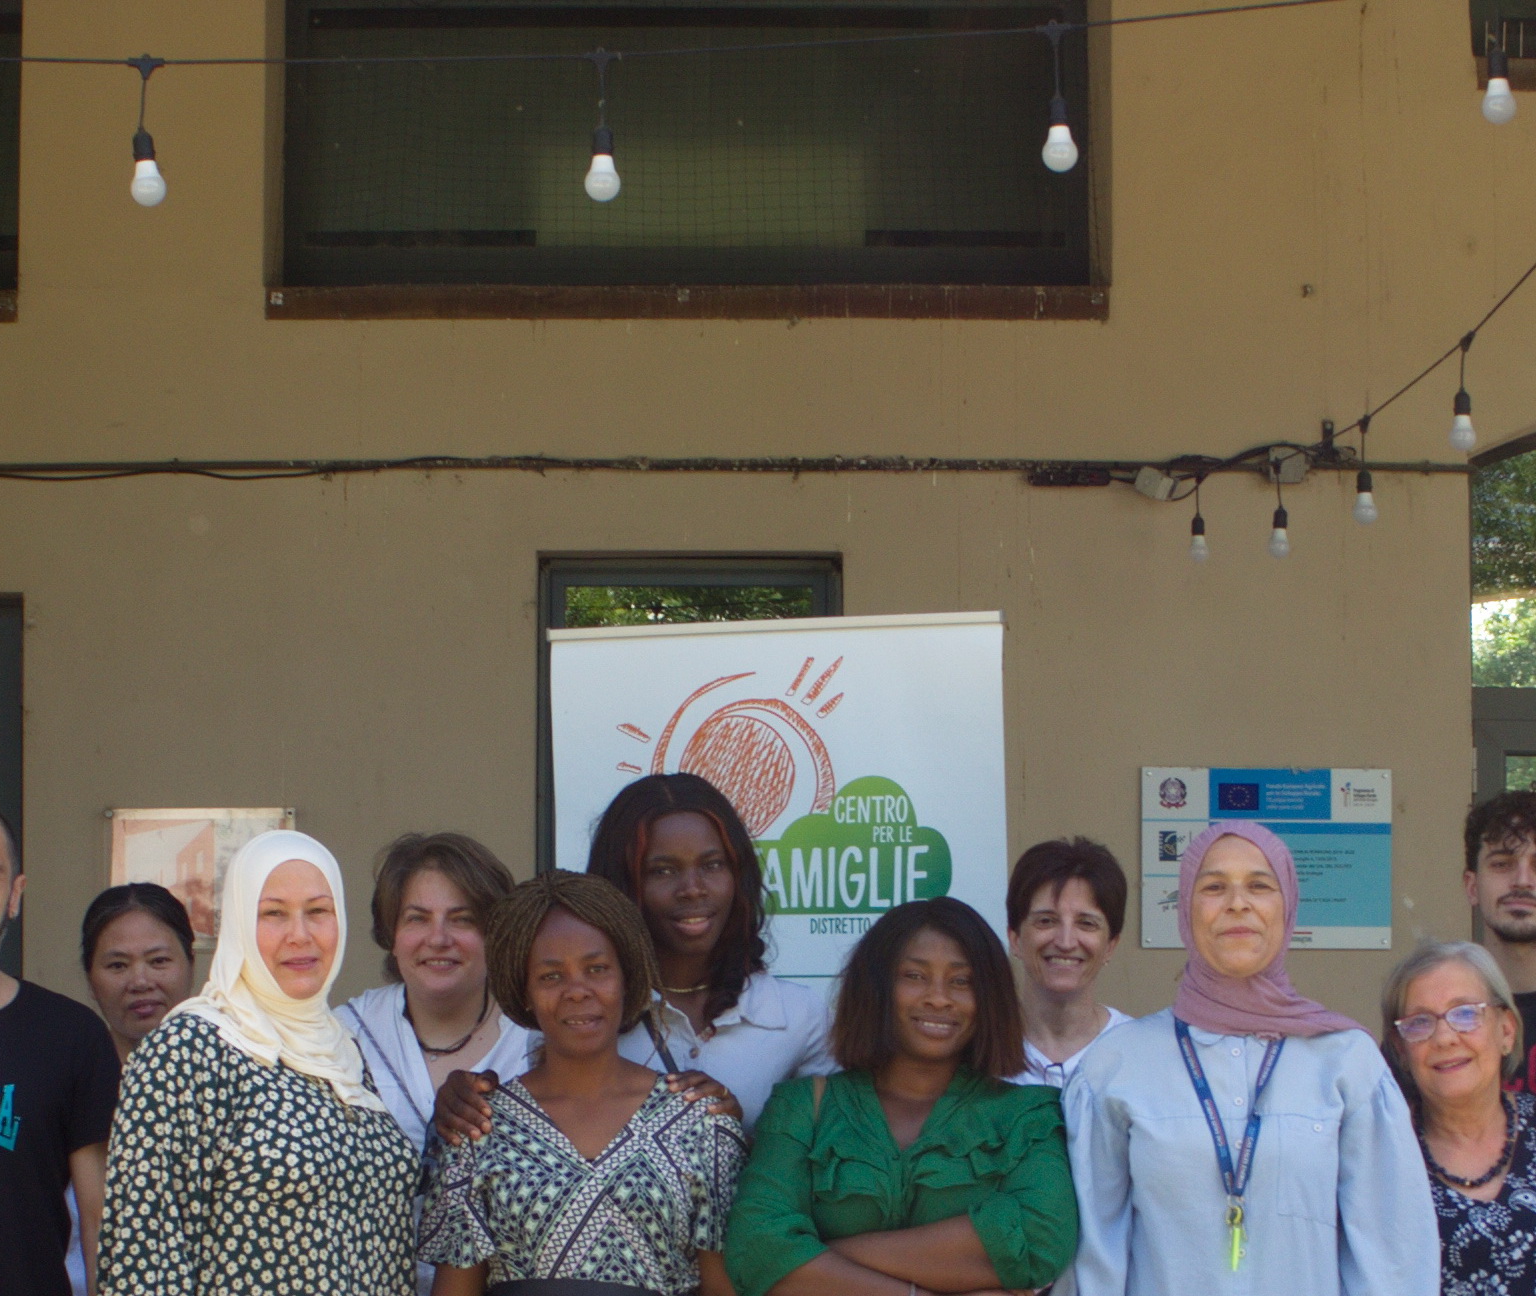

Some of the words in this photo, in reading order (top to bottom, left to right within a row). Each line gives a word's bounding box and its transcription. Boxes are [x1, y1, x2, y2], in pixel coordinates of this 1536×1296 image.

[834, 795, 909, 824] CENTRO
[872, 827, 894, 843] PER
[899, 826, 913, 842] LE
[754, 845, 930, 909] AMIGLIE
[810, 917, 871, 934] DISTRETTO
